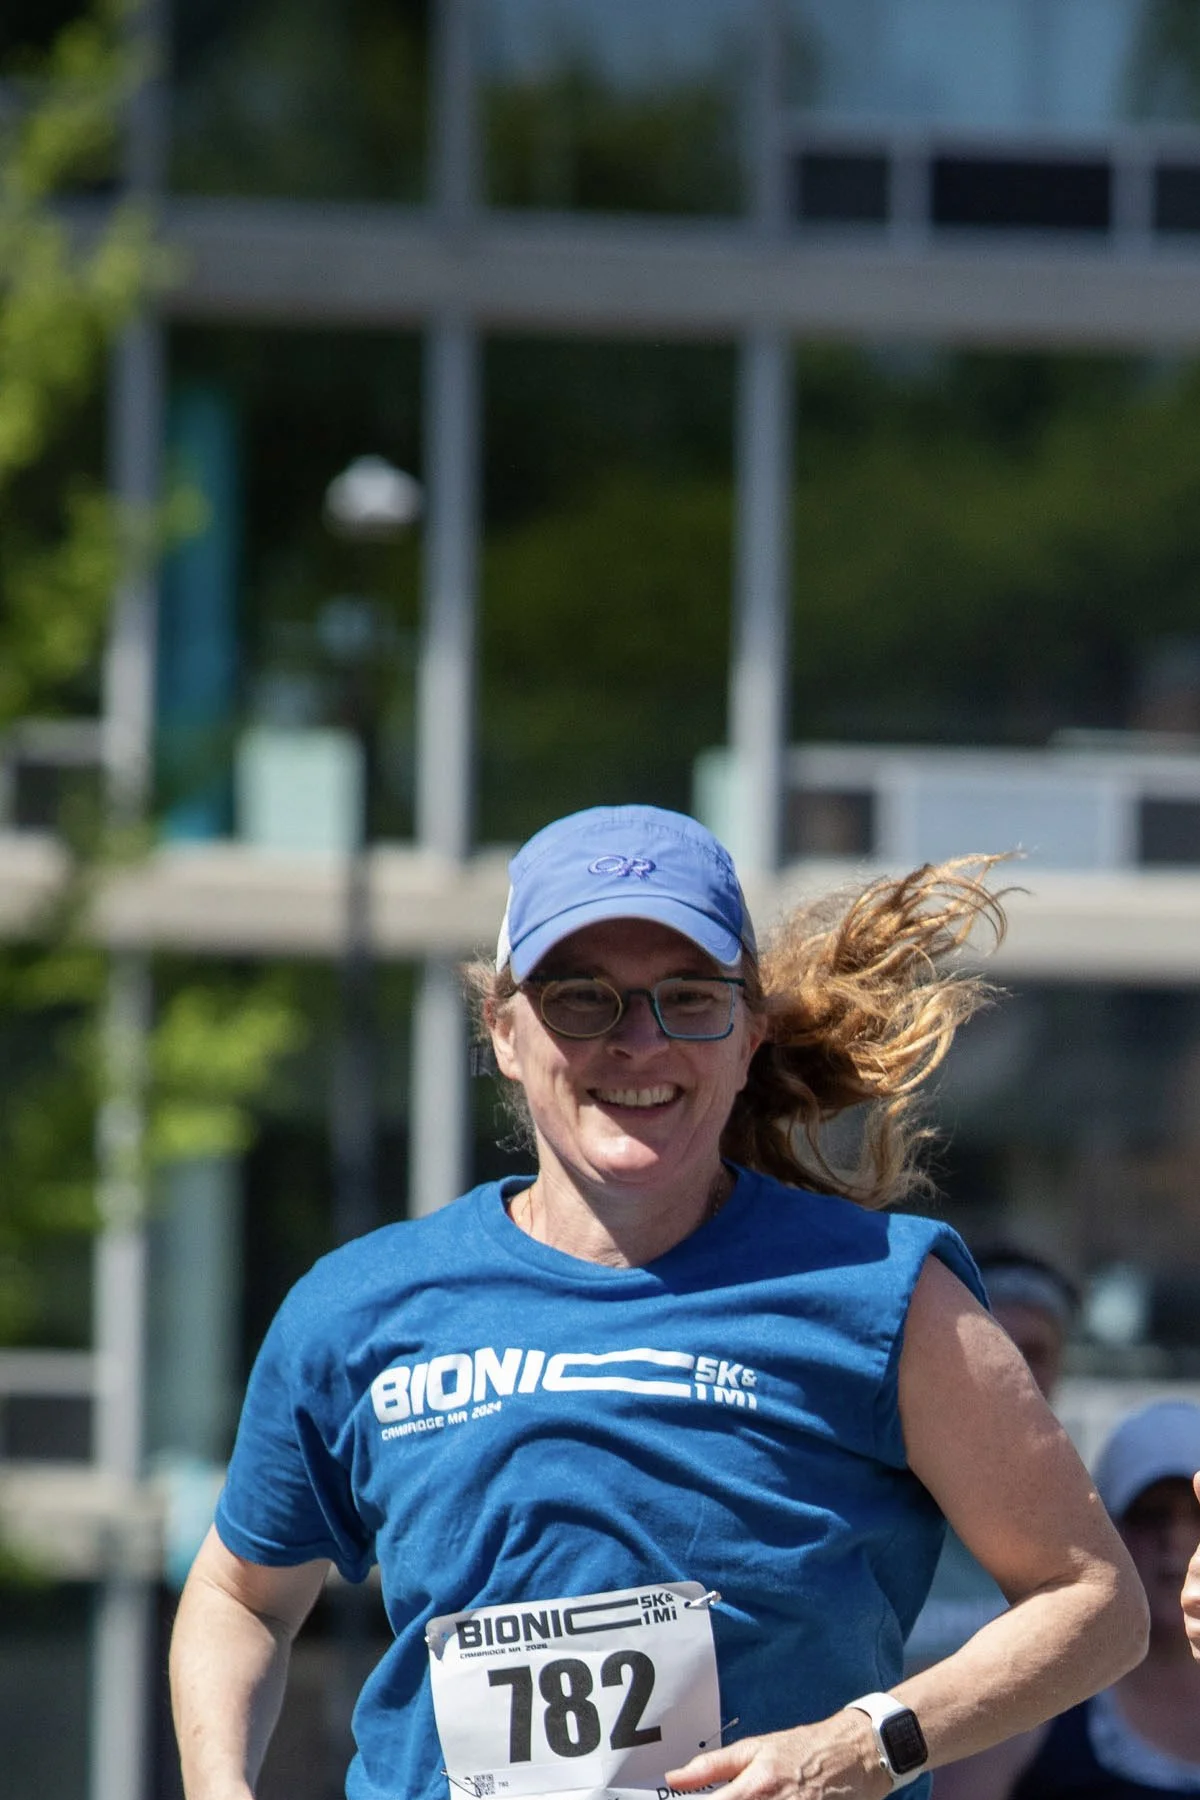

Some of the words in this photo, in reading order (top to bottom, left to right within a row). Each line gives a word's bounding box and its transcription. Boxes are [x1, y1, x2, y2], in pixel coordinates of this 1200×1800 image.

[371, 1347, 695, 1425] BIONIC
[447, 1410, 468, 1426] MA
[455, 1598, 642, 1650] BIONIC
[487, 1649, 662, 1764] 782
